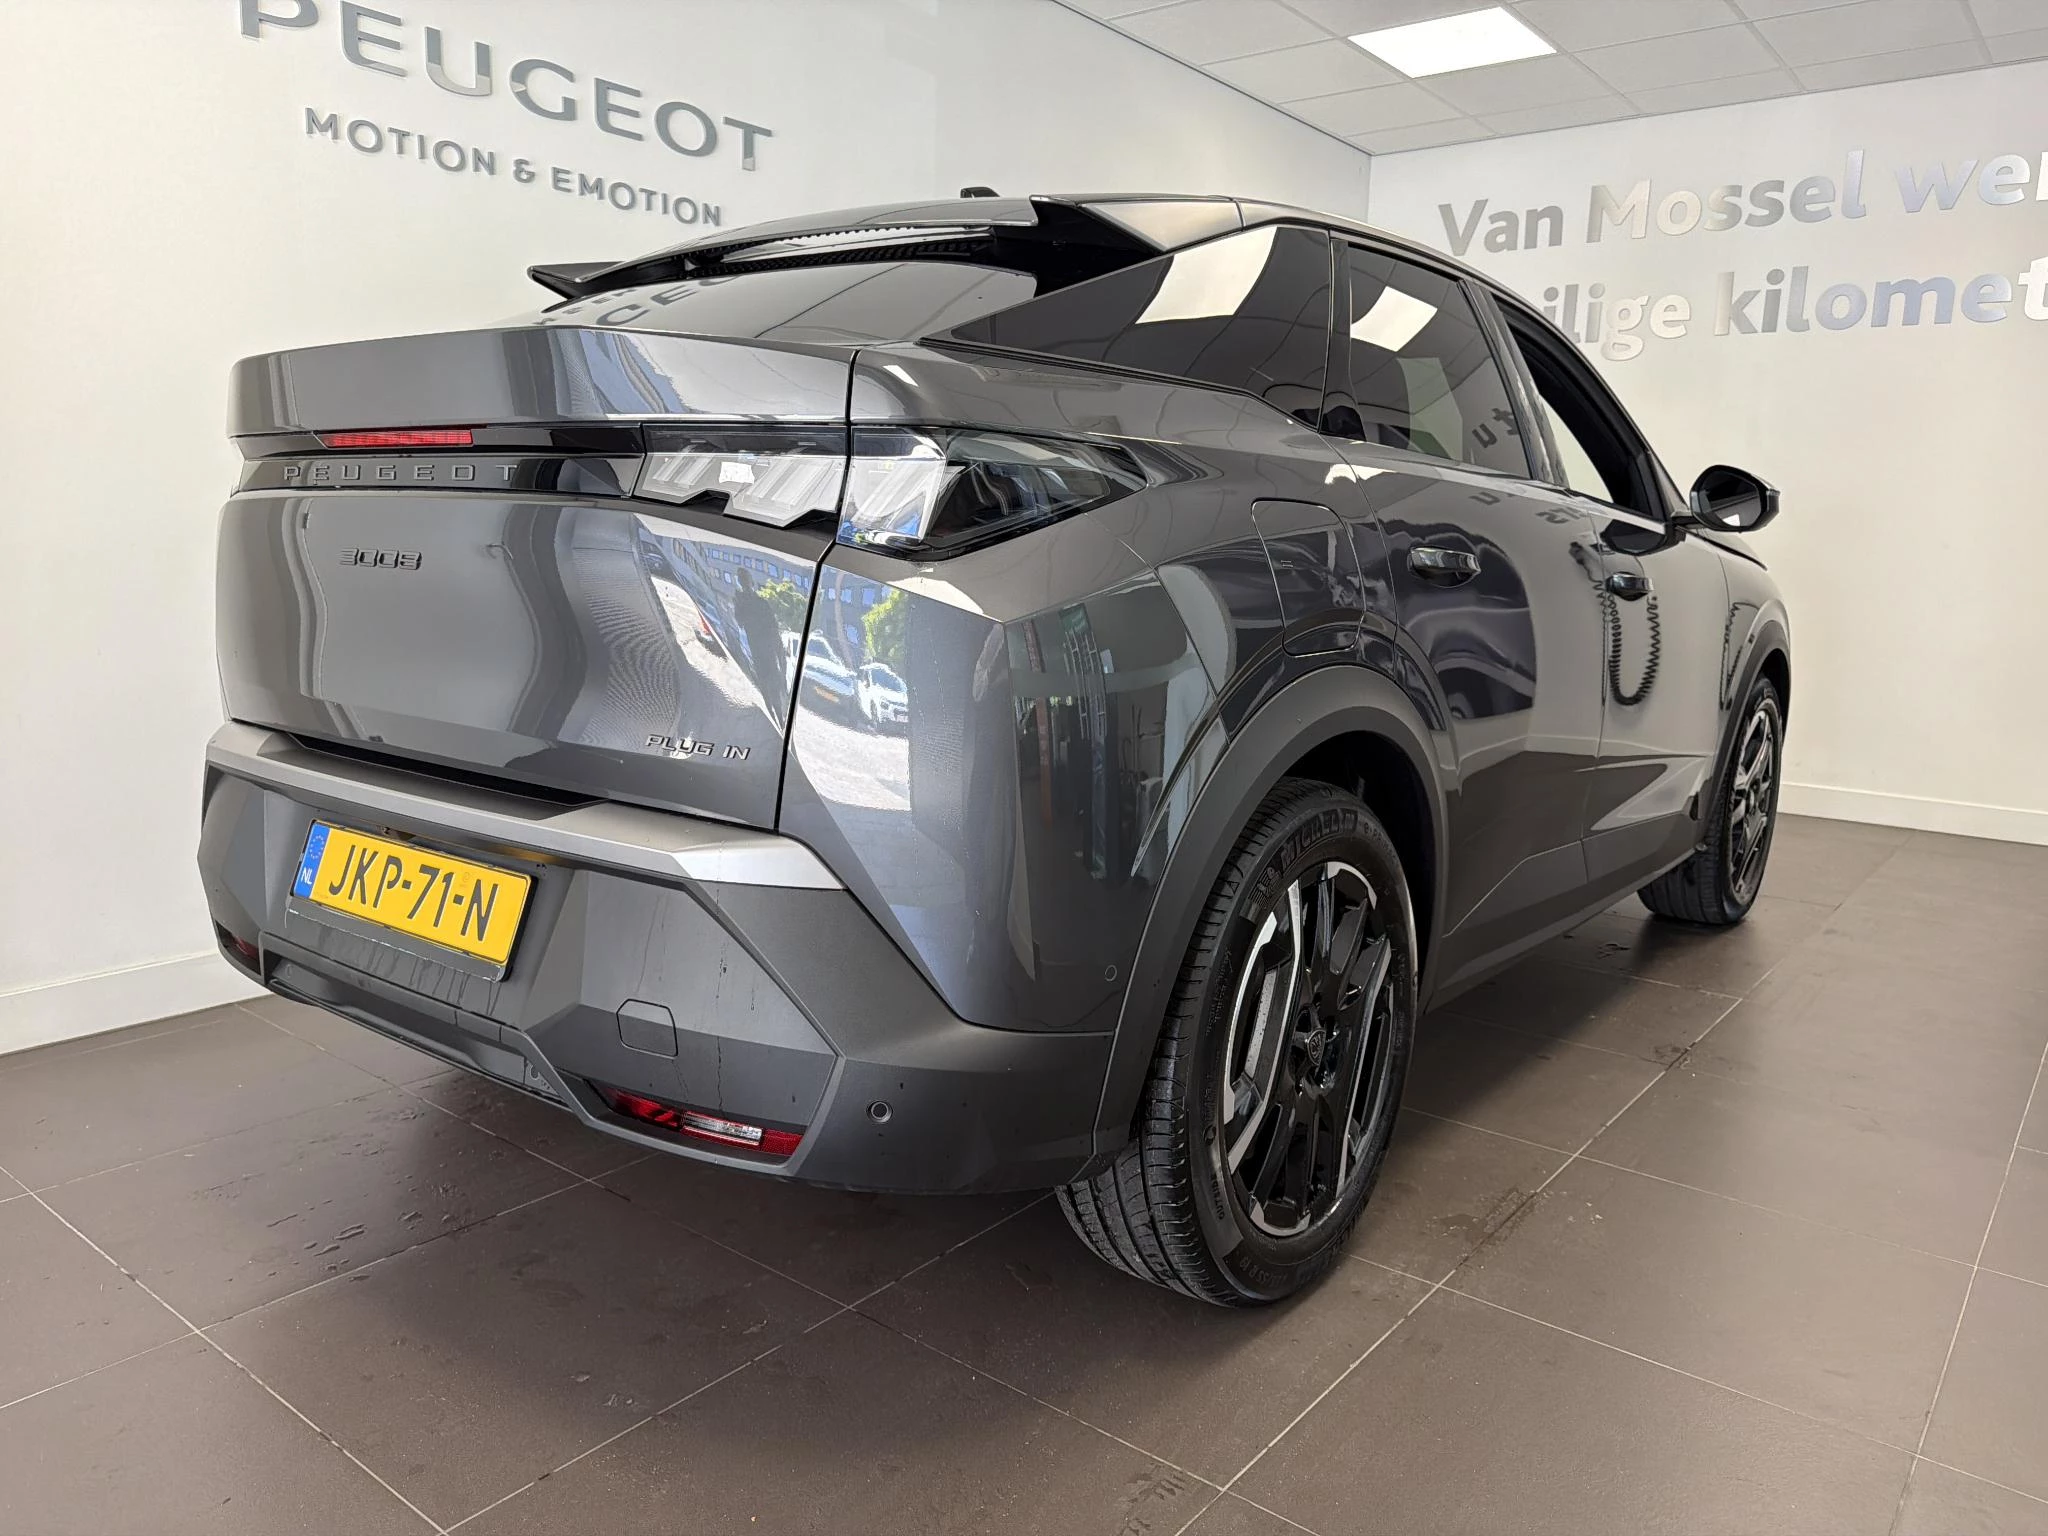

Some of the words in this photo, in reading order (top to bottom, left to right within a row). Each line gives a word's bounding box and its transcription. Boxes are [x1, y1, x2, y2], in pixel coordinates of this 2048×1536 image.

[240, 0, 773, 171] PEUGEOT
[305, 107, 496, 176] MOTION
[512, 158, 537, 184] &
[551, 166, 722, 227] EMOTION
[1438, 198, 1565, 257] Van
[1585, 149, 1867, 244] Mossel
[284, 464, 517, 482] PEUGEOT
[339, 548, 422, 571] 3008
[645, 733, 714, 757] PLUG
[723, 745, 751, 761] IN
[1280, 808, 1356, 871] MICHELIN
[301, 867, 313, 885] NL
[328, 844, 499, 942] JKP-71-N
